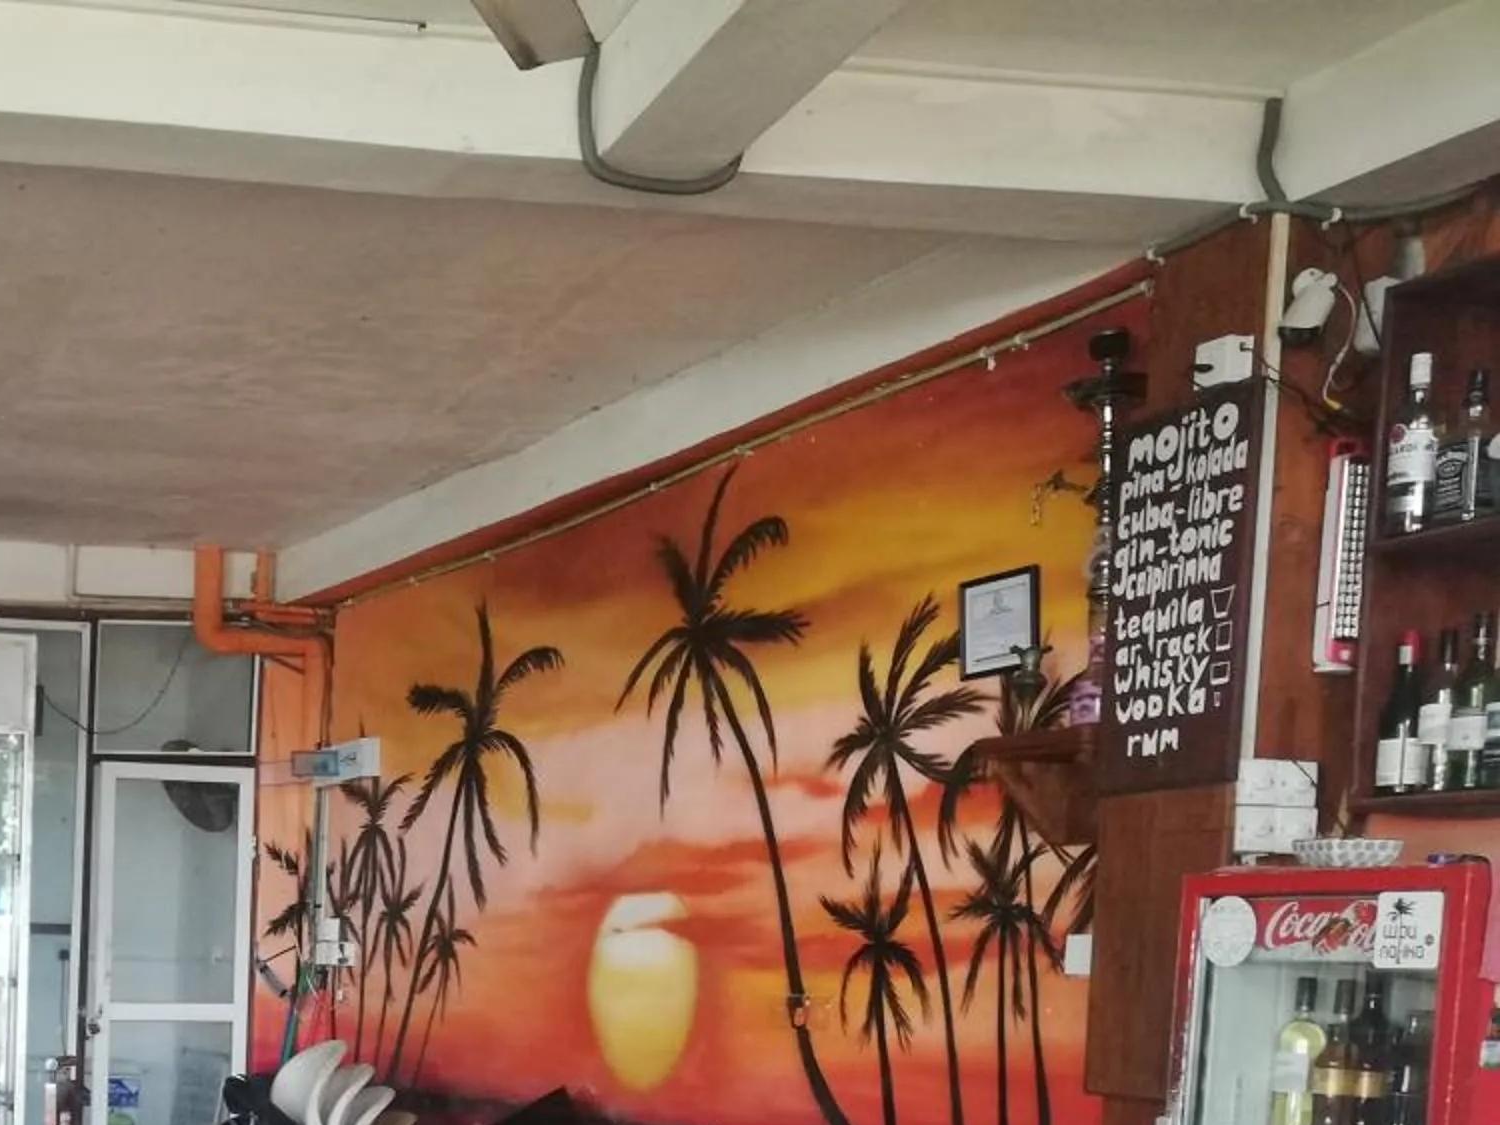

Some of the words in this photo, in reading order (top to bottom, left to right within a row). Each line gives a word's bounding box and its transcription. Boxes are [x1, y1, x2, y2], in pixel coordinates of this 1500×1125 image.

[1128, 402, 1240, 481] mojito
[1118, 482, 1243, 540] cuba-libre
[1112, 517, 1234, 597] gin-tonic
[1114, 590, 1204, 653] tequila
[1127, 727, 1179, 757] rum
